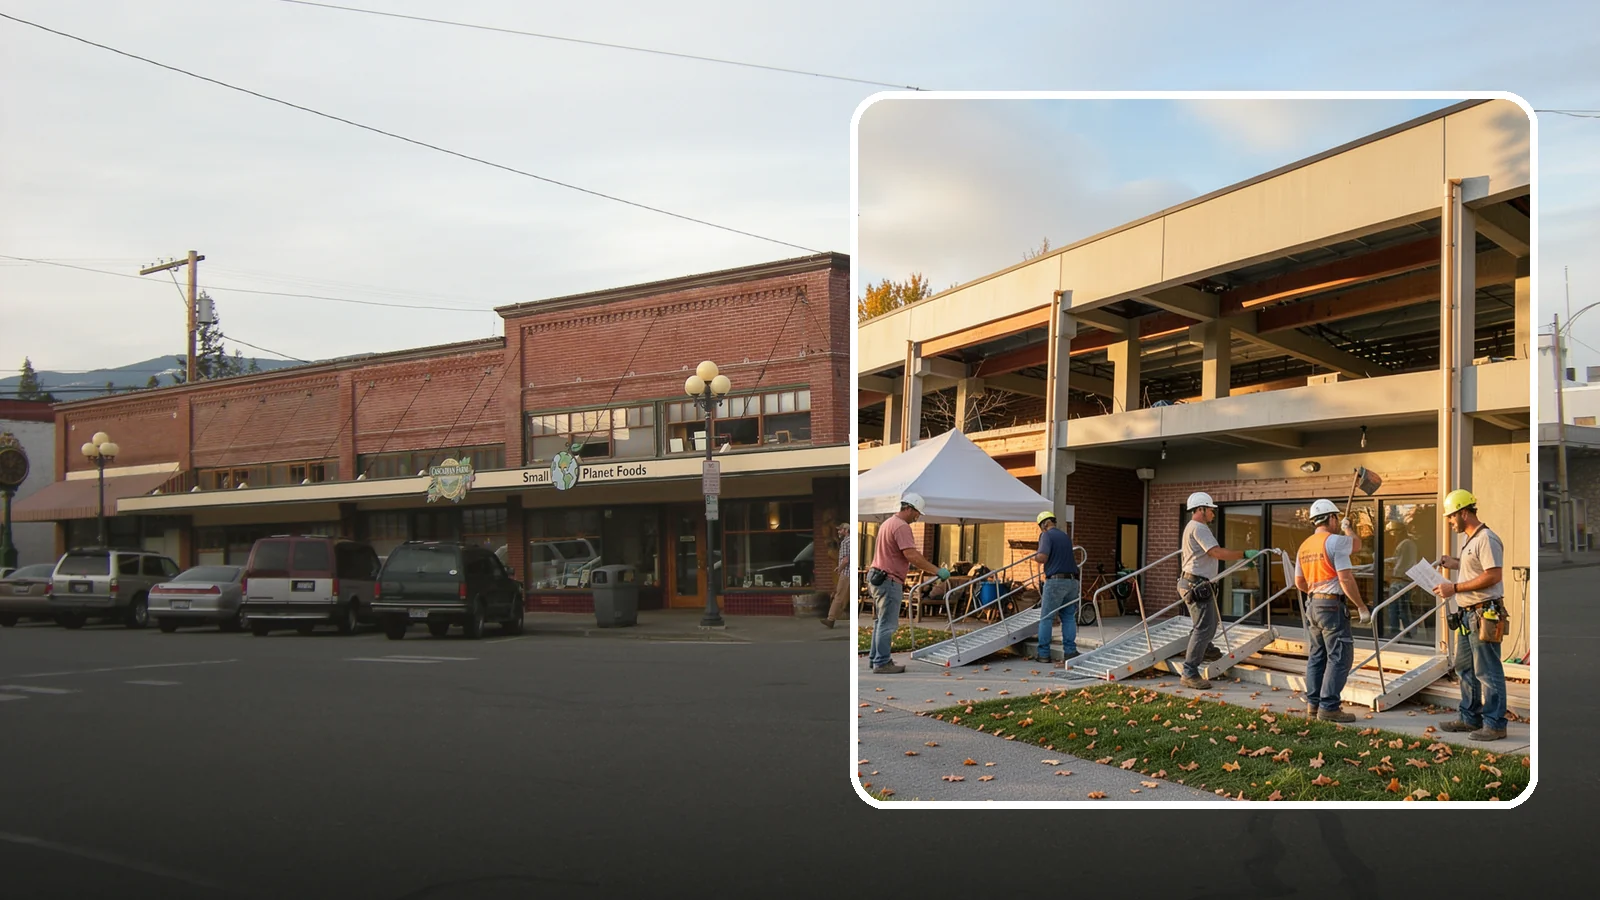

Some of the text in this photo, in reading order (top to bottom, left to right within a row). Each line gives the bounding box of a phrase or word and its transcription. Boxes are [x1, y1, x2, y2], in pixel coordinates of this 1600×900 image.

[523, 465, 646, 482] Small Planet Foods
